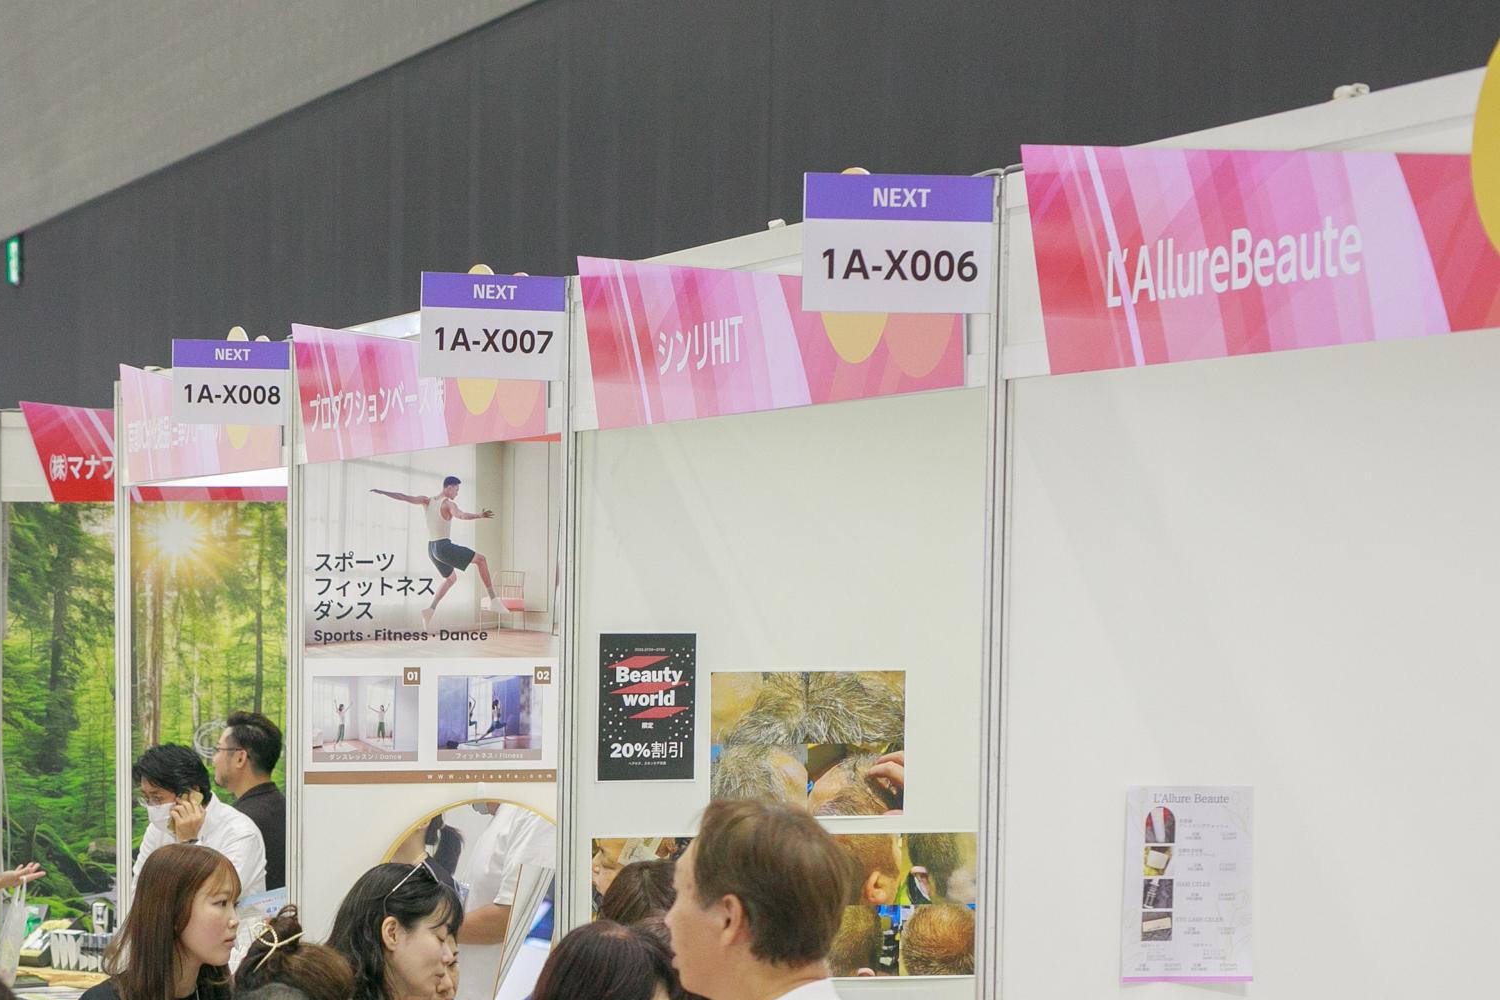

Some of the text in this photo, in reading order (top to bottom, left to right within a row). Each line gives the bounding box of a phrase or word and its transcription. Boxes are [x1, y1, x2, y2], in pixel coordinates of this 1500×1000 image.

[872, 187, 931, 208] NEXT
[821, 247, 979, 284] 1A-X006
[473, 283, 518, 300] NEXT
[435, 326, 553, 354] 1A-X007
[657, 314, 743, 377] シンリHIT
[214, 348, 251, 361] NEXT
[184, 384, 281, 404] 1A-X008
[314, 551, 395, 572] スポーツ
[315, 576, 435, 597] フィットネス
[313, 600, 374, 621] ダンス
[314, 628, 488, 644] Sports Fitness Dance
[406, 671, 418, 681] 01
[536, 671, 550, 680] 02
[615, 666, 683, 686] Beauty
[622, 690, 676, 706] world
[610, 741, 683, 759] 20%割引
